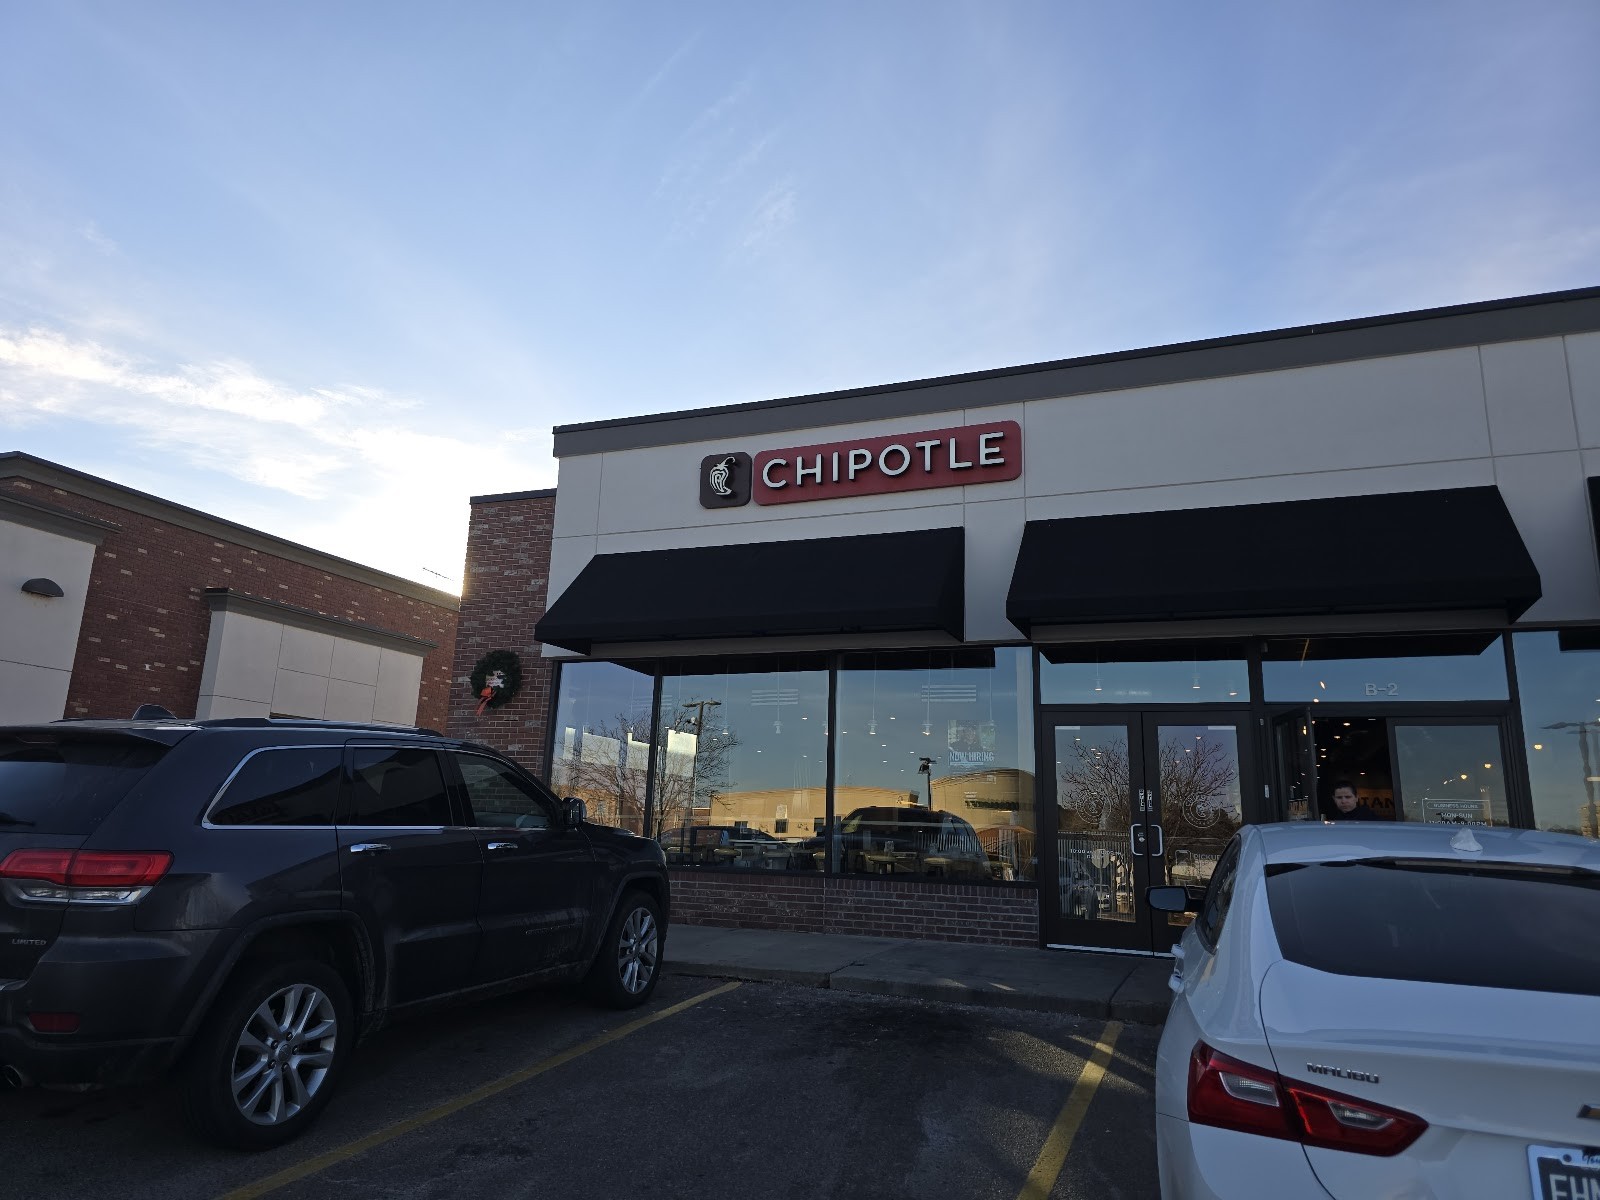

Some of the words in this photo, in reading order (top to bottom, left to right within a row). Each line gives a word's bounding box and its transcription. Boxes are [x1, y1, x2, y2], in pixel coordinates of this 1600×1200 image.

[762, 431, 1005, 489] CHIPOTLE
[1365, 682, 1399, 696] B-2
[949, 751, 967, 762] NOW
[968, 751, 995, 762] HIRING
[11, 938, 47, 946] LIMITED
[1306, 1062, 1380, 1084] MALIBU
